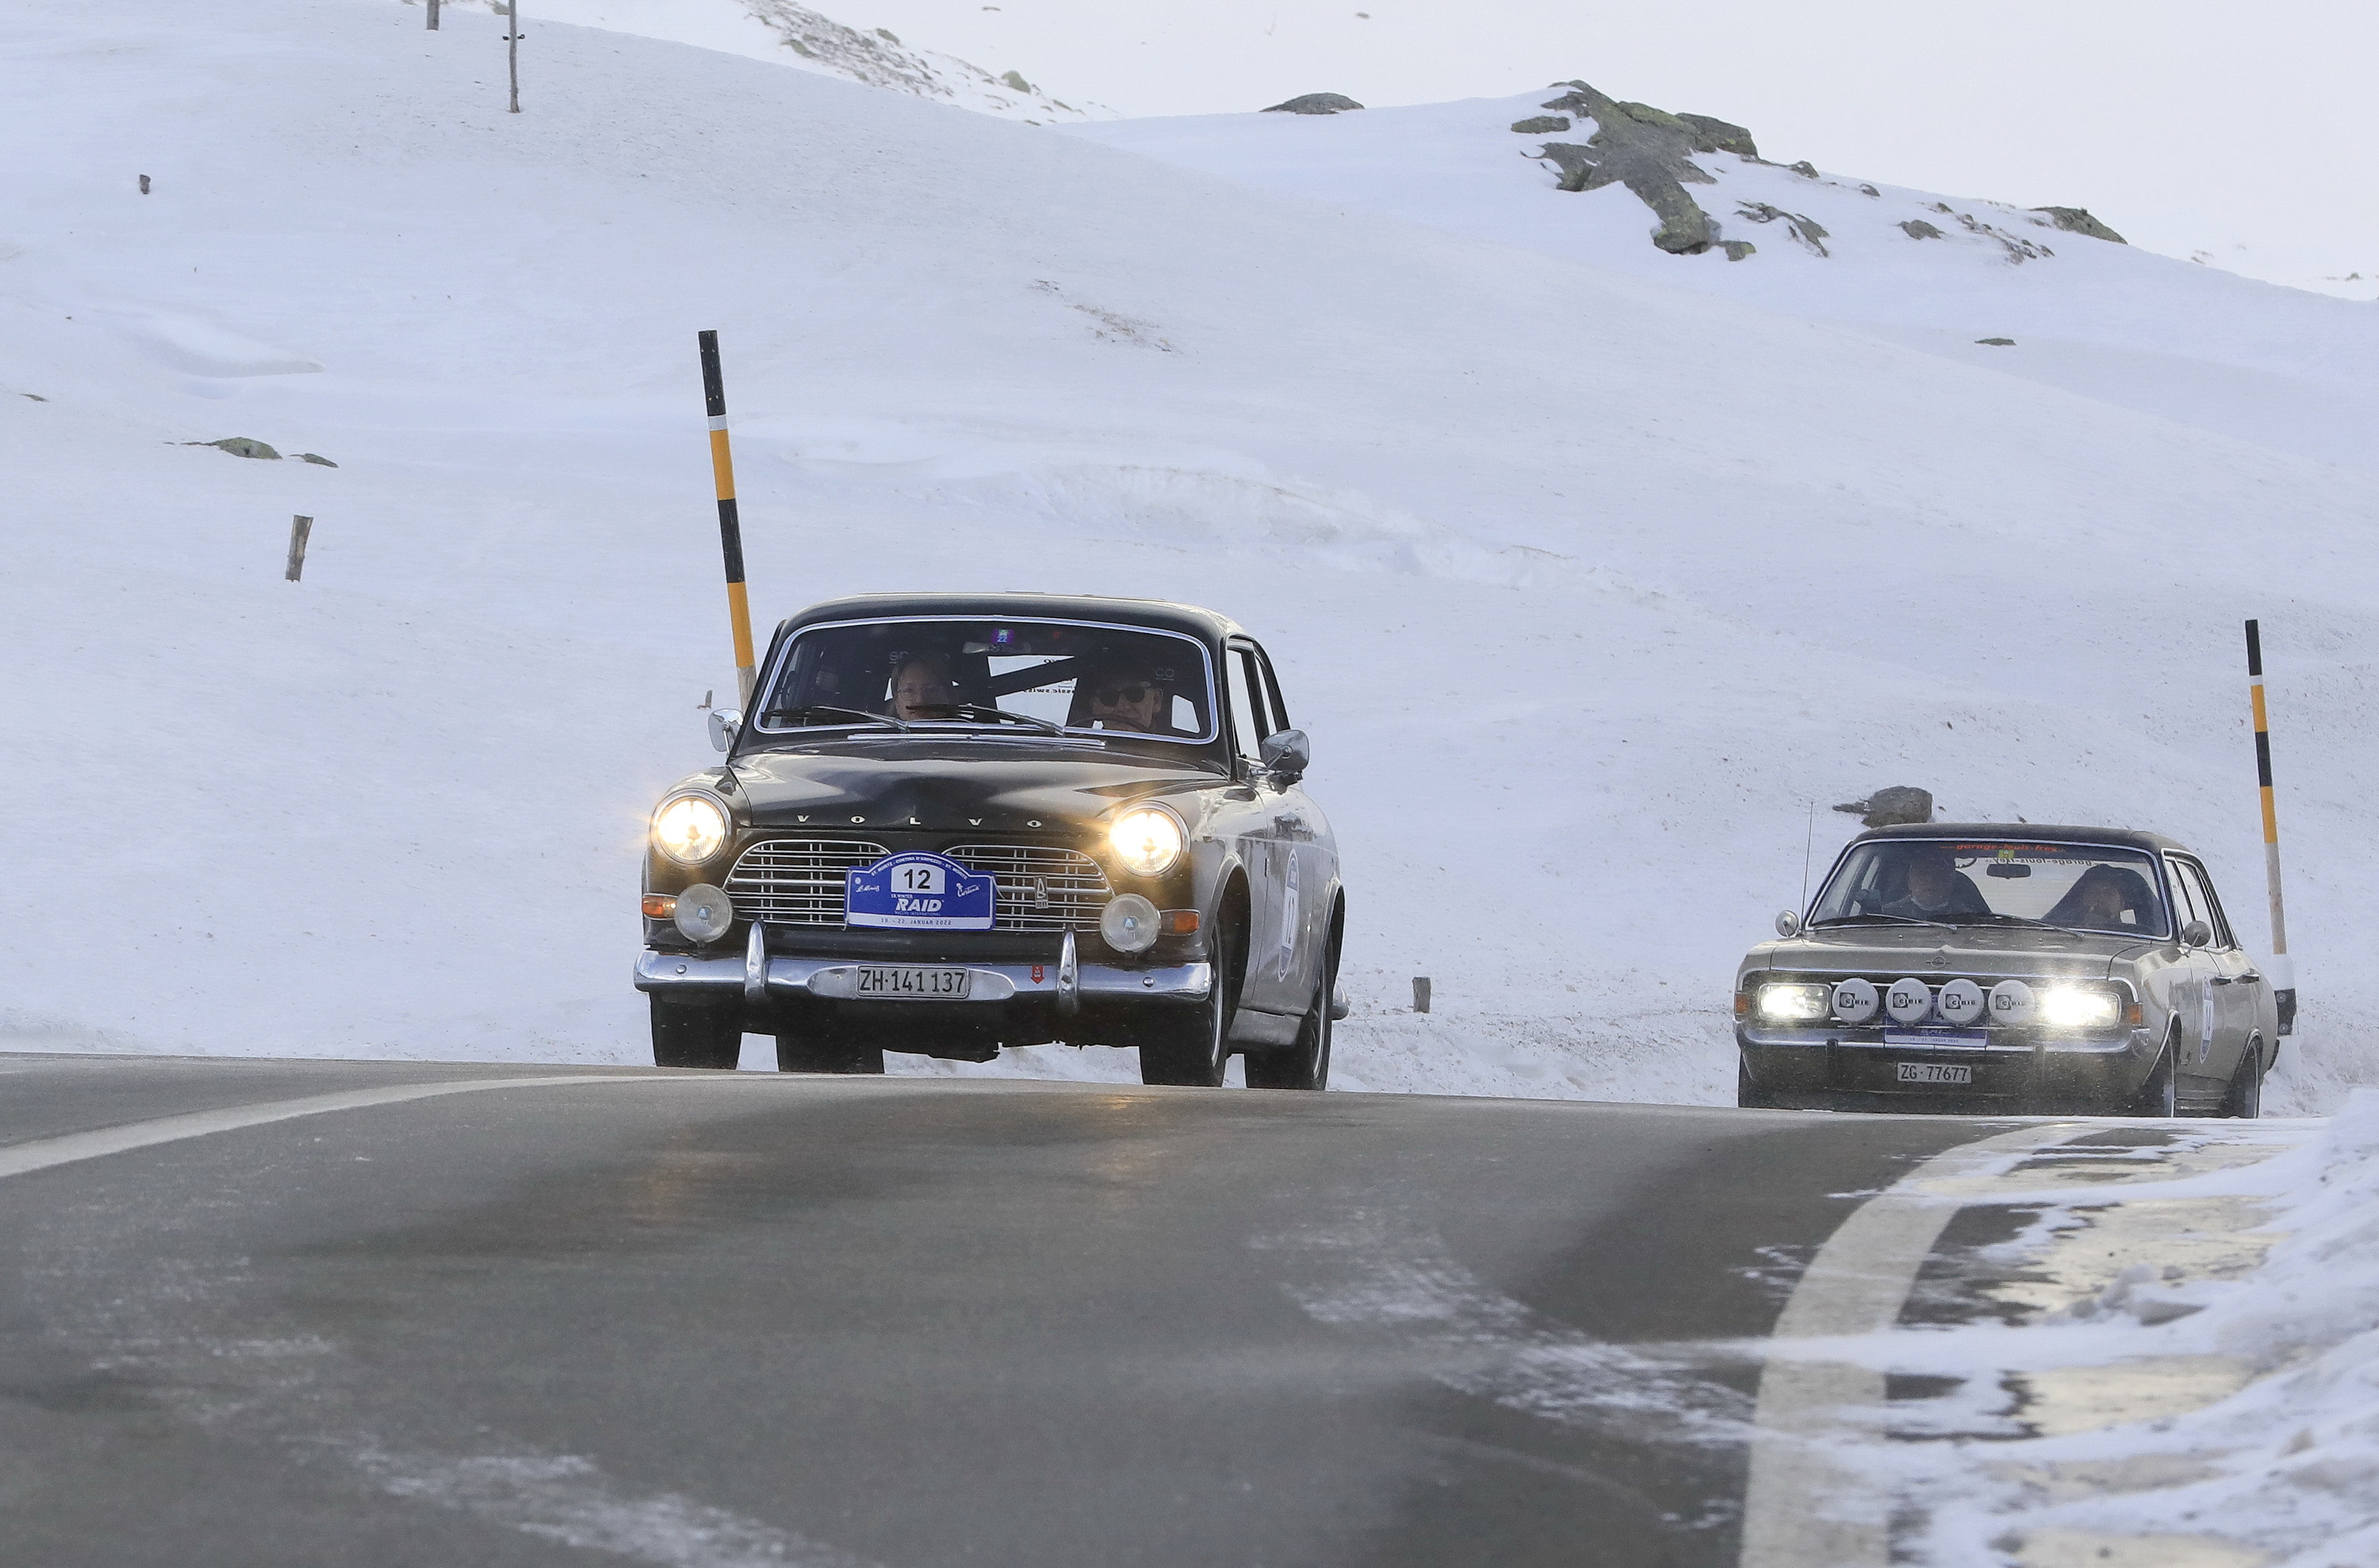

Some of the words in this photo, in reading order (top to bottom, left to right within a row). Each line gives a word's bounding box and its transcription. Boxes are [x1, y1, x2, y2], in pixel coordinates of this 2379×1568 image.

[796, 815, 1042, 828] VOLVO
[904, 868, 931, 890] 12
[895, 898, 942, 912] RAID
